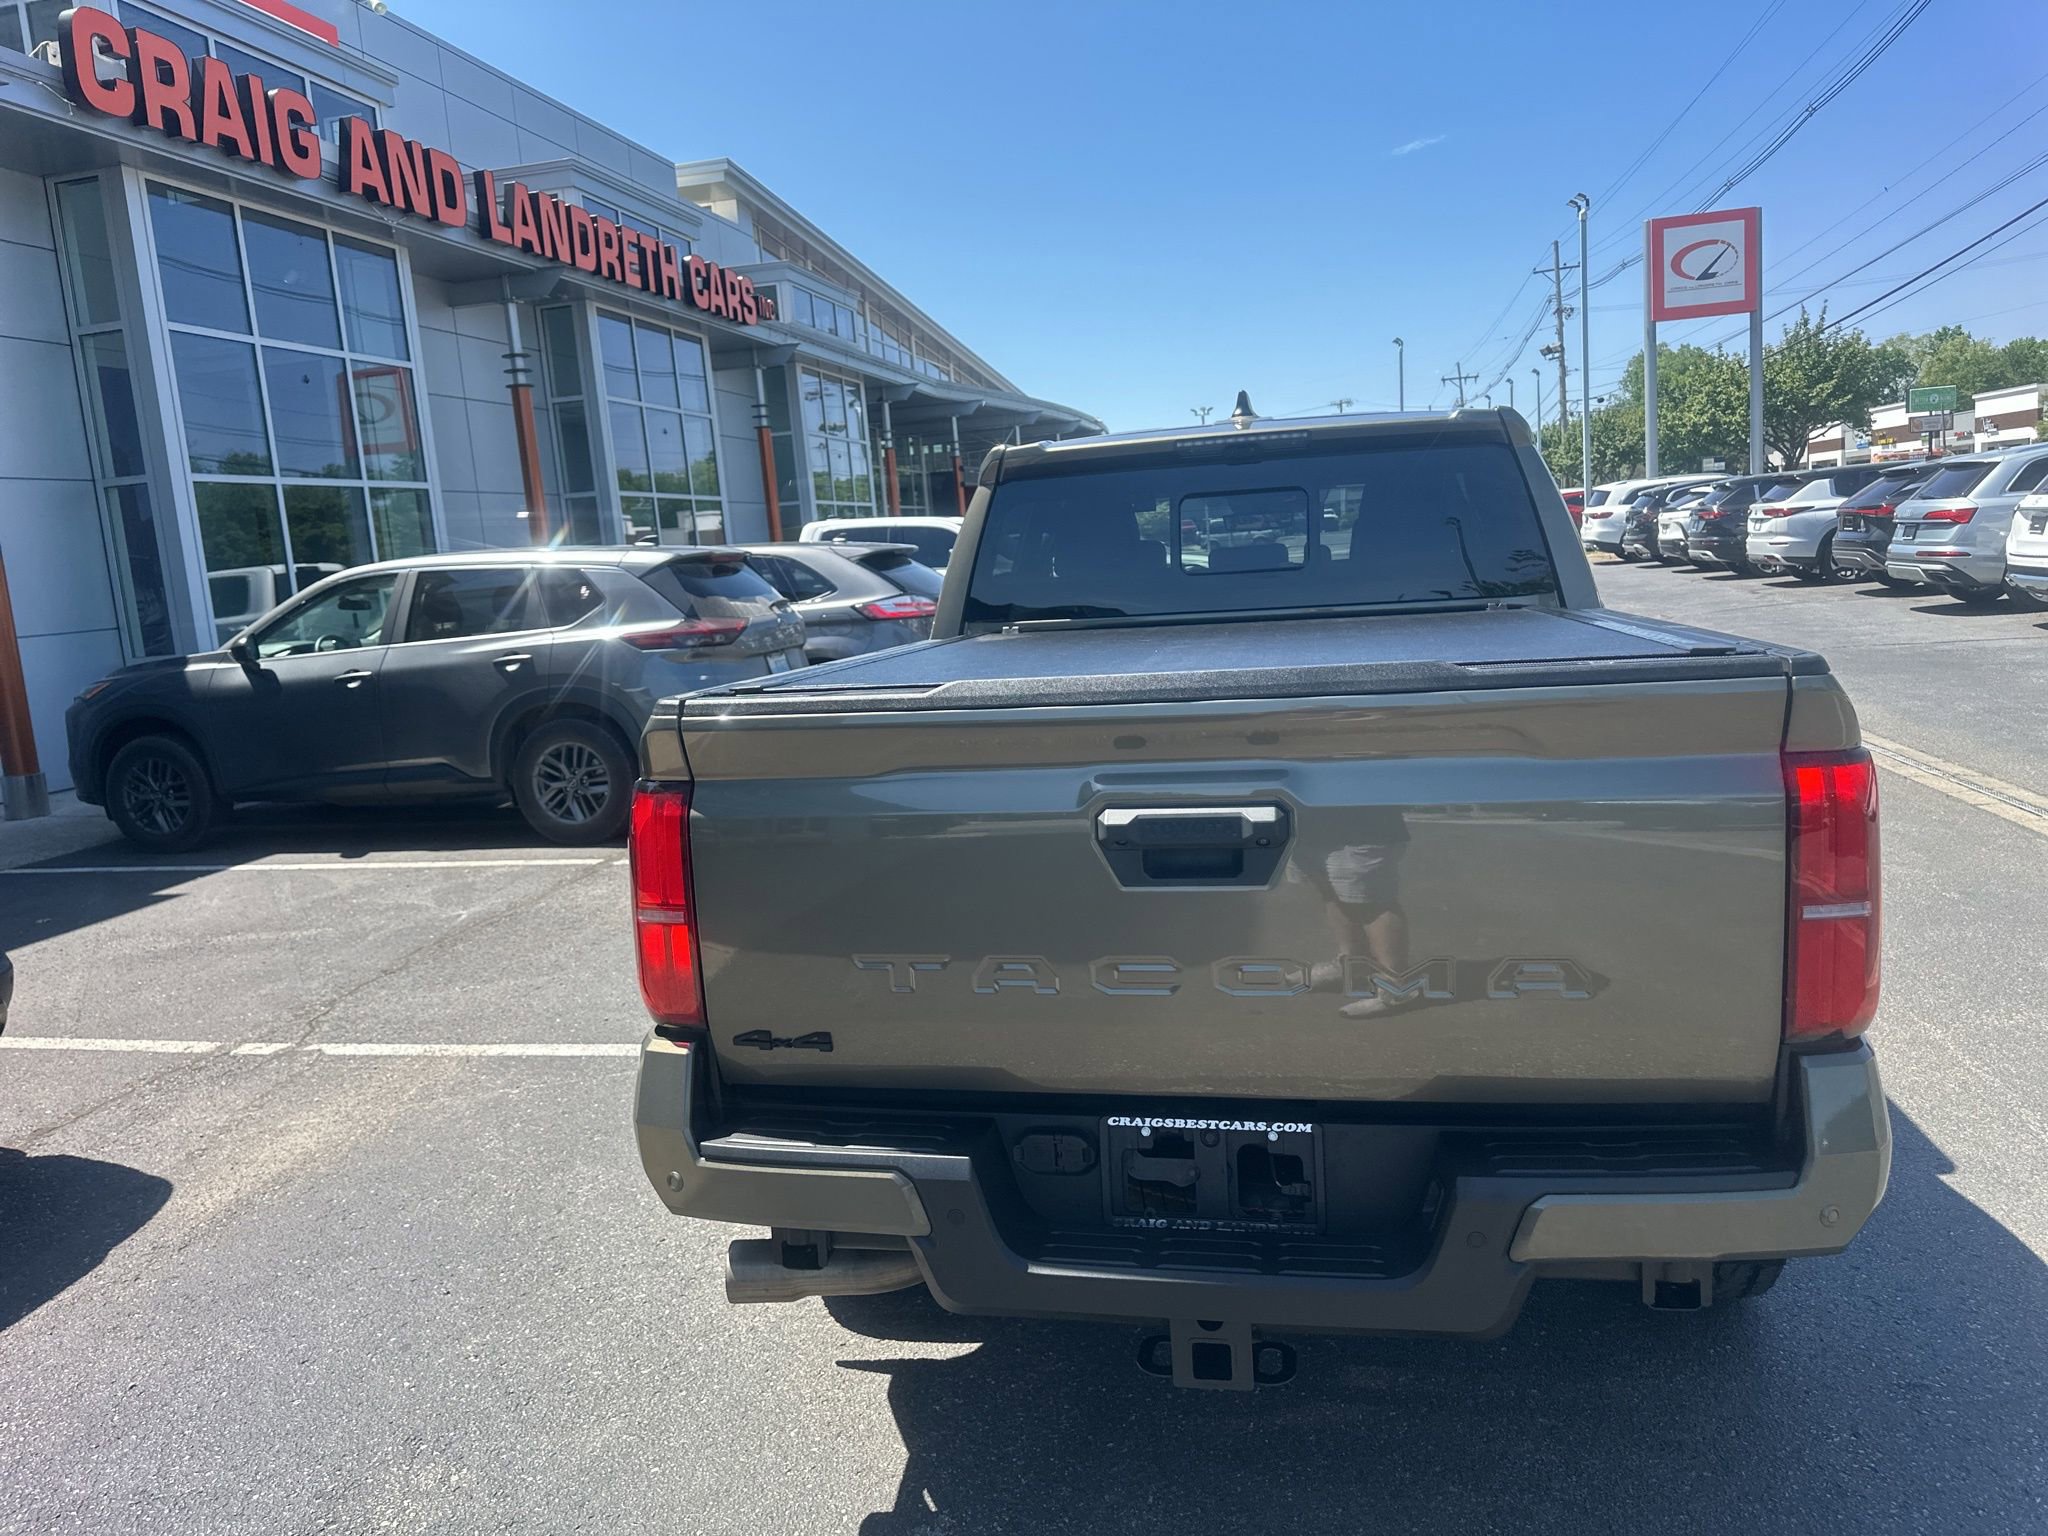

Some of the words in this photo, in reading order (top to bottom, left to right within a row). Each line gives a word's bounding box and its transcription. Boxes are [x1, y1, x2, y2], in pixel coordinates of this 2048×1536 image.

[60, 6, 322, 180] CRAIG
[341, 115, 468, 228] AND
[476, 169, 682, 300] LANDRETH
[684, 254, 758, 326] CARS
[851, 953, 1594, 999] TACOMA
[1107, 1116, 1313, 1133] CRAIGSBESTCARS.COM
[1112, 1217, 1168, 1229] CRAIG
[1171, 1219, 1212, 1230] AND
[1215, 1221, 1317, 1235] LANDRE
